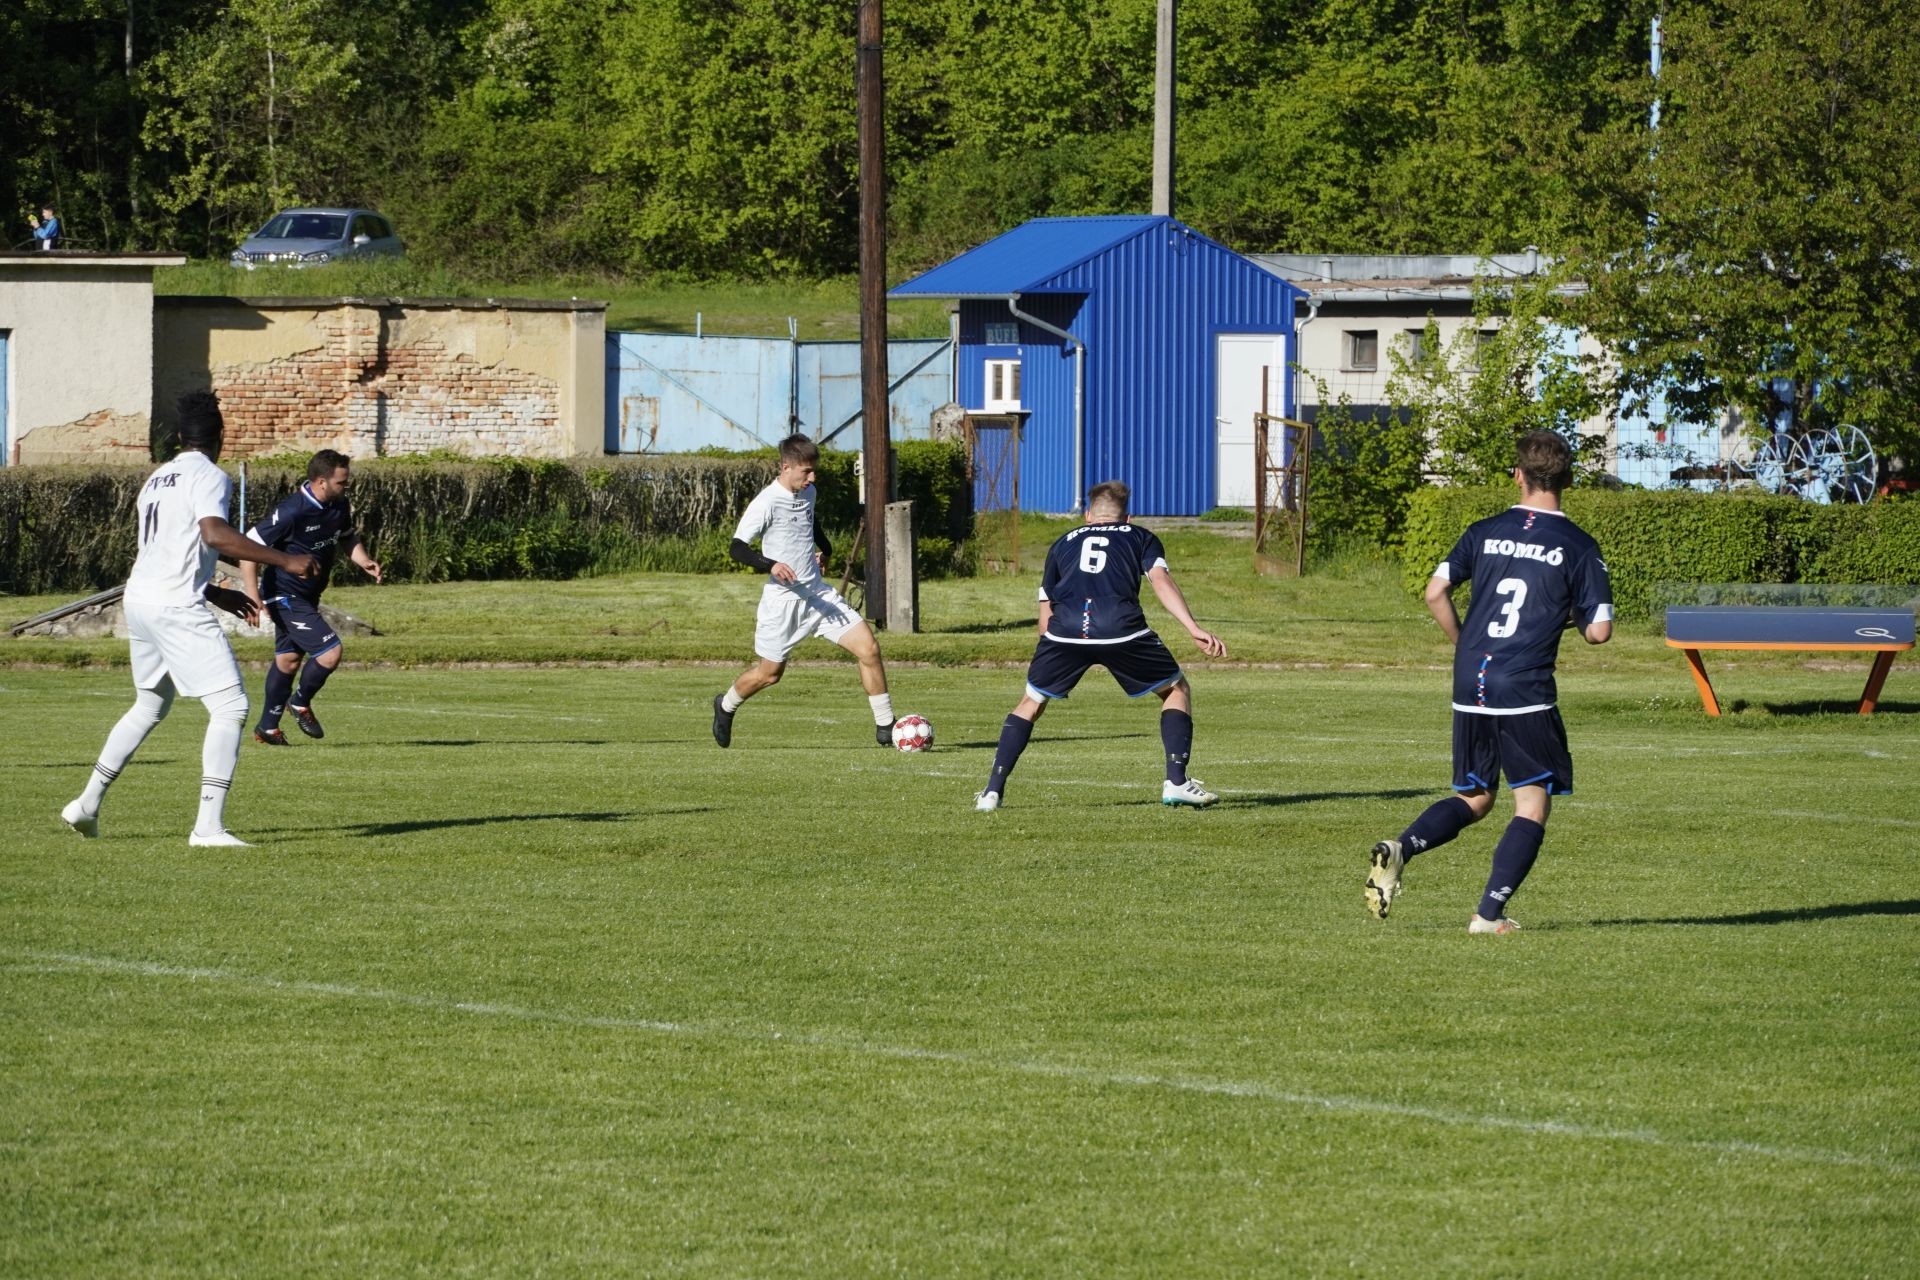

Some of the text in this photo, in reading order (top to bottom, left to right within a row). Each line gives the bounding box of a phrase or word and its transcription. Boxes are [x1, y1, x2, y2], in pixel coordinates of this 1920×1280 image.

[144, 500, 160, 547] 11
[1080, 536, 1110, 574] 6
[1483, 539, 1563, 566] KOMLÓ
[1487, 578, 1527, 638] 3
